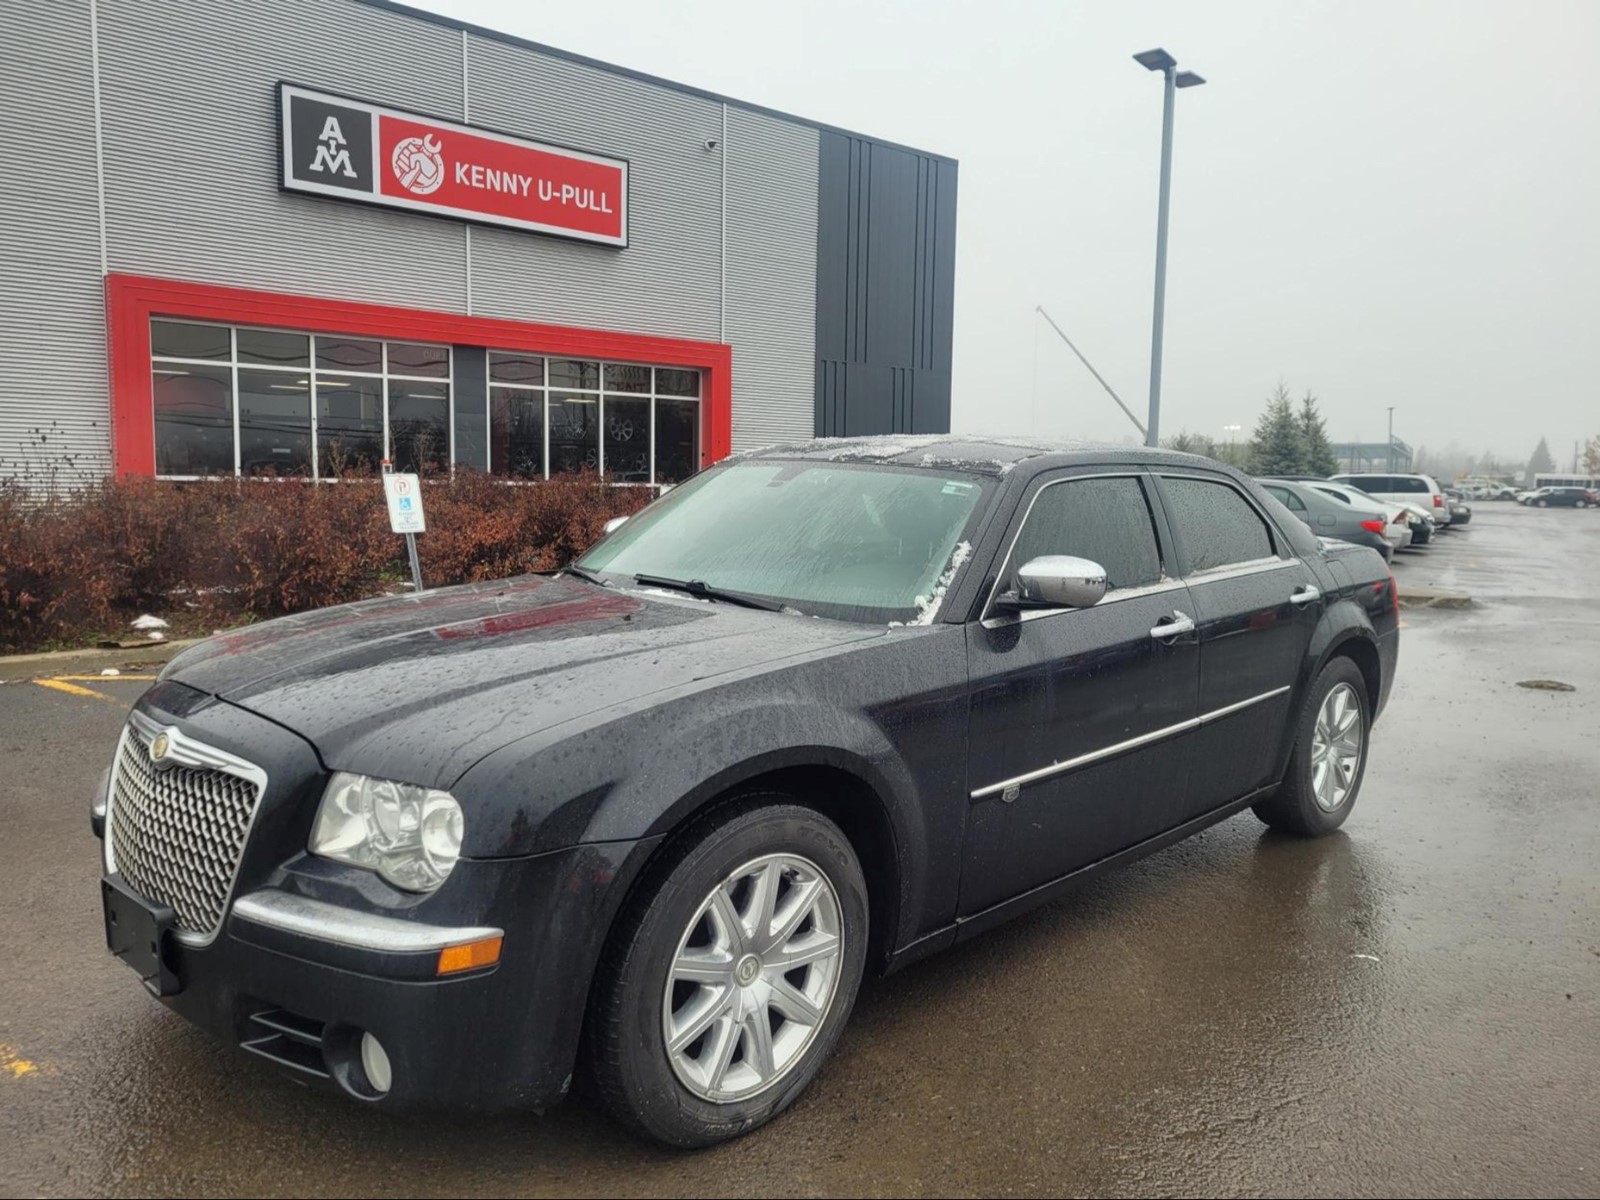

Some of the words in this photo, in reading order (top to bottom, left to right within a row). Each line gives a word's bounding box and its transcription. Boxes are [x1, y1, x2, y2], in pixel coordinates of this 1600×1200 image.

[309, 116, 358, 178] AIM
[455, 161, 532, 197] KENNY
[538, 179, 613, 214] U-PULL
